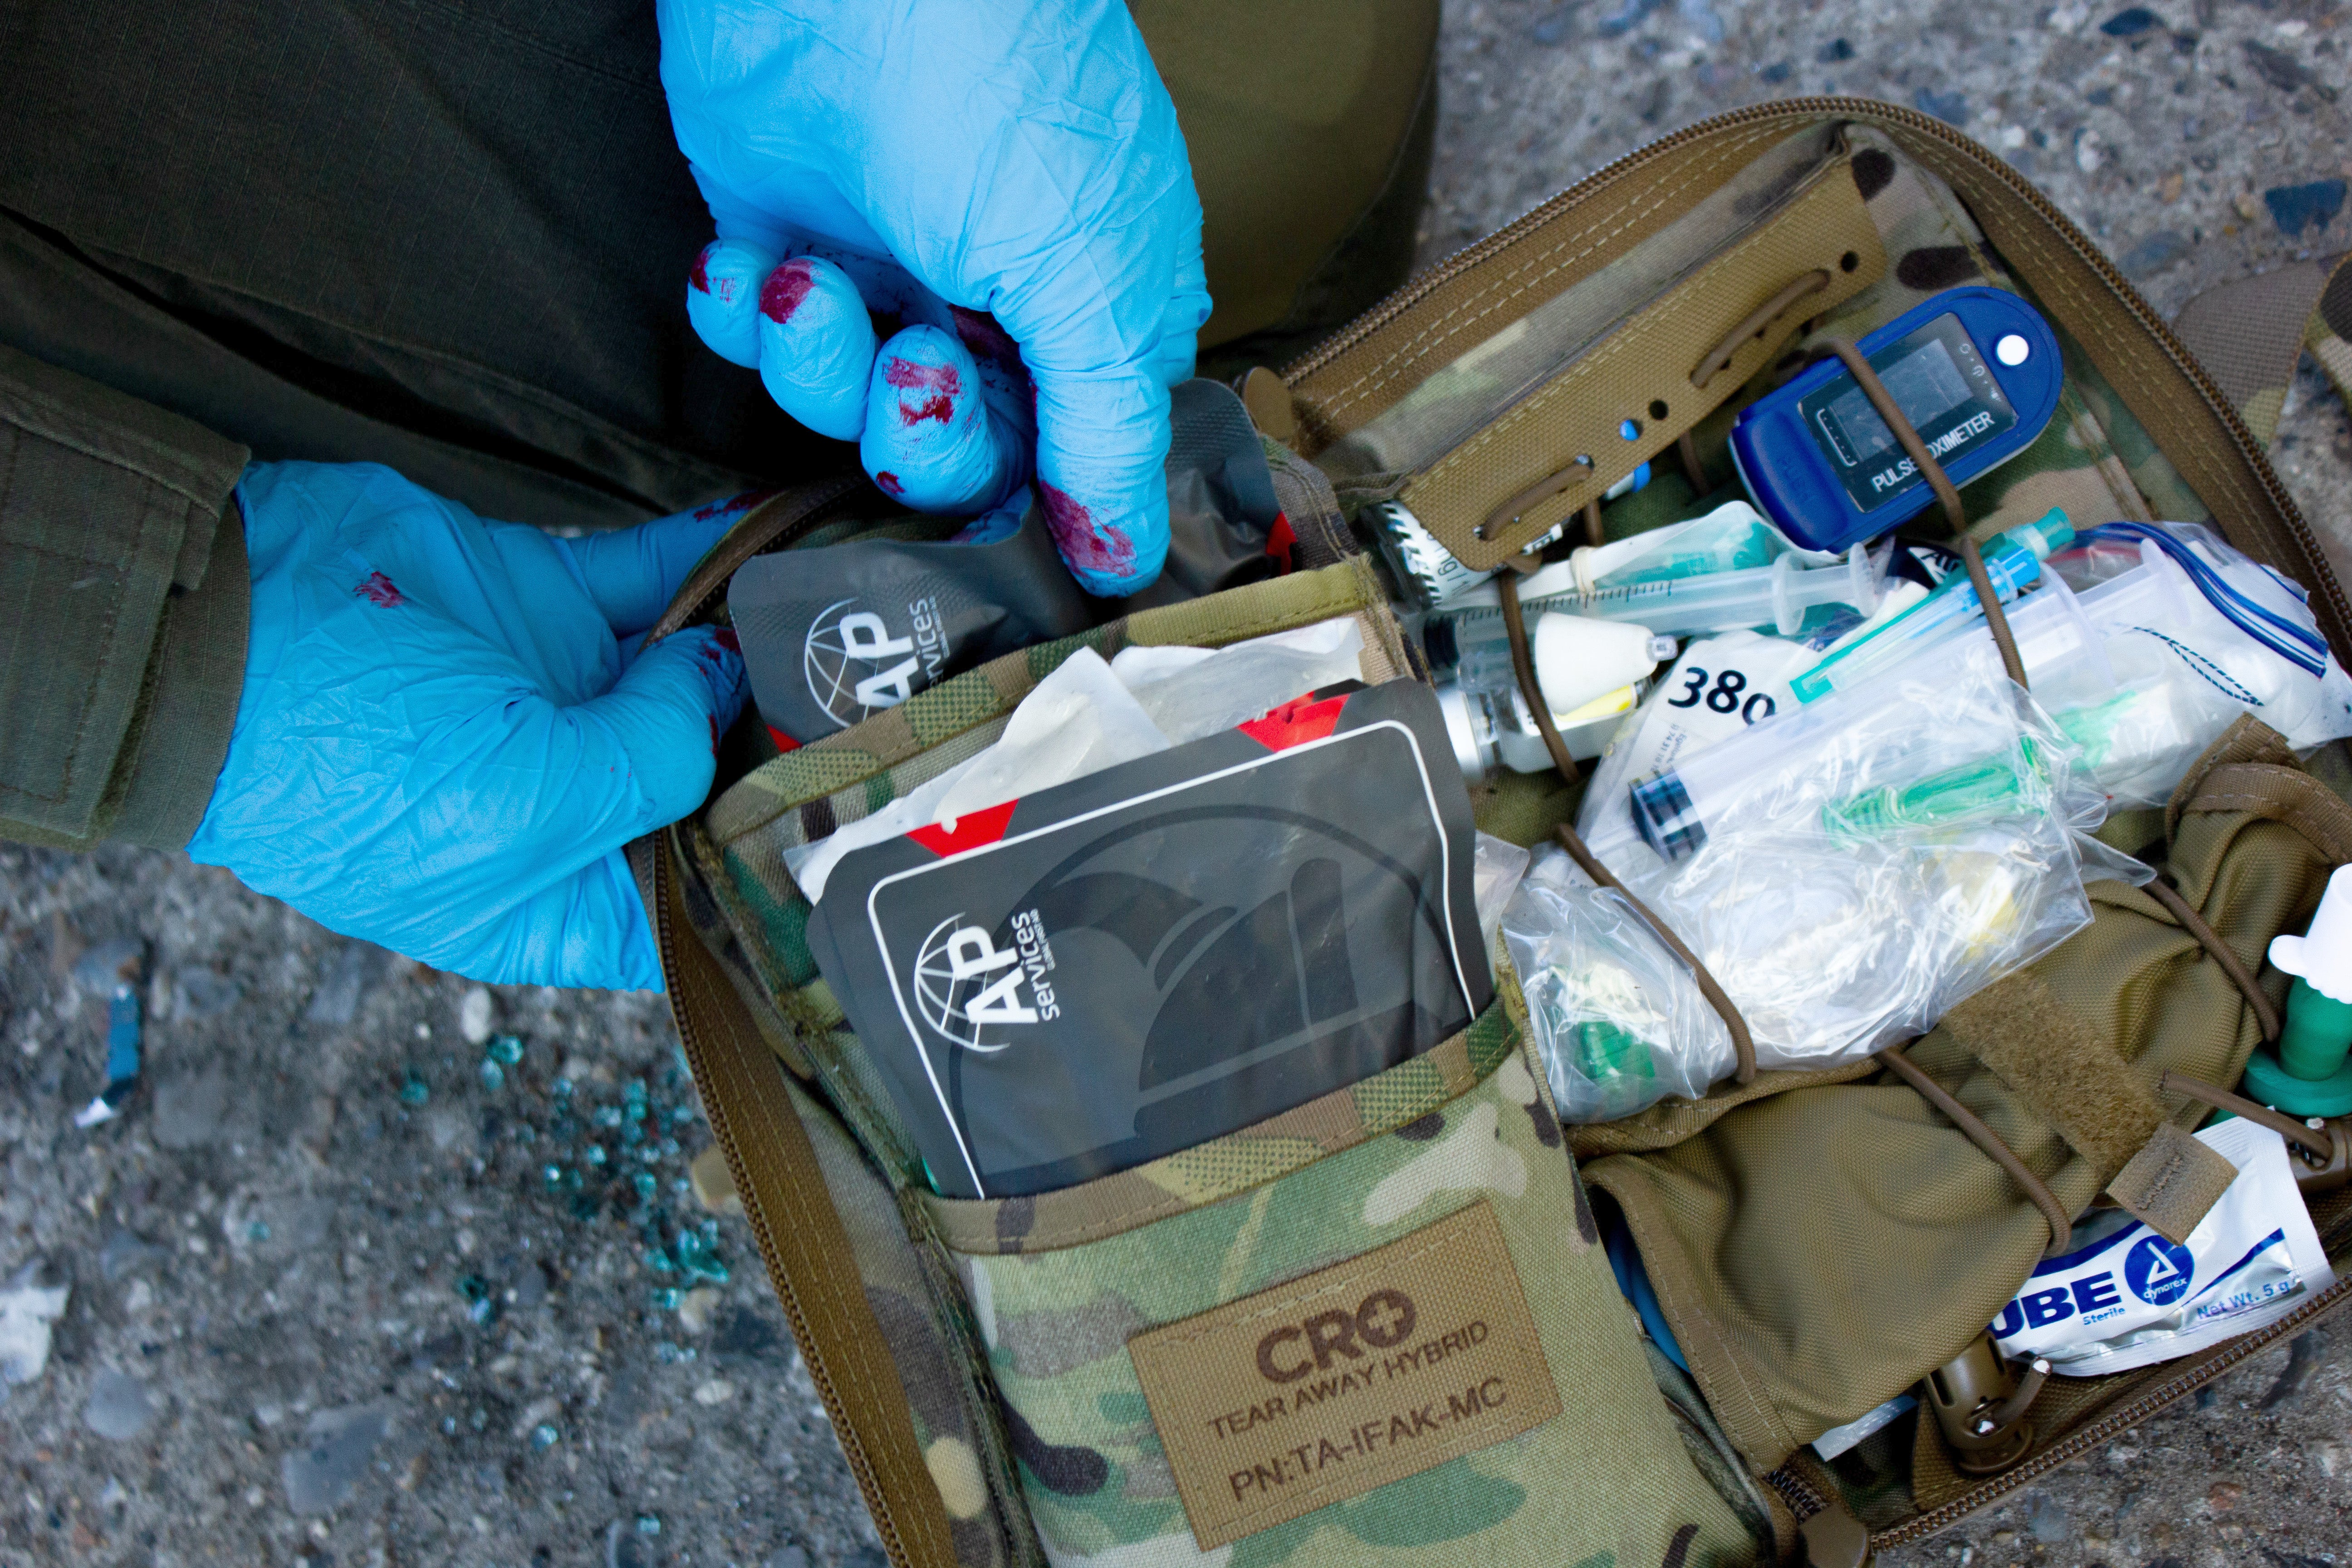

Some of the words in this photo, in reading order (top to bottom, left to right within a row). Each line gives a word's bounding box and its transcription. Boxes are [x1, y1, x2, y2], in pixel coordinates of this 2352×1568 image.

[1870, 456, 1919, 492] PULSE
[1926, 411, 1995, 459] OXIMETER
[839, 611, 918, 708] AP
[1668, 666, 1776, 726] 380
[947, 925, 1038, 1024] AP
[1011, 912, 1060, 1021] services
[1986, 1271, 2122, 1339] UBE
[2083, 1307, 2126, 1326] Sterile
[2143, 1277, 2188, 1299] dynarex
[2197, 1301, 2227, 1319] Net
[2229, 1292, 2259, 1308] Wt.
[2263, 1283, 2274, 1297] 5
[2279, 1281, 2290, 1294] g
[1209, 1394, 1289, 1440] TEAR
[1294, 1362, 1380, 1412] AWAY
[1383, 1319, 1489, 1379] HYBRID
[1255, 1288, 1416, 1384] CRO
[1229, 1376, 1508, 1502] PN:TA-IFAK-MC
